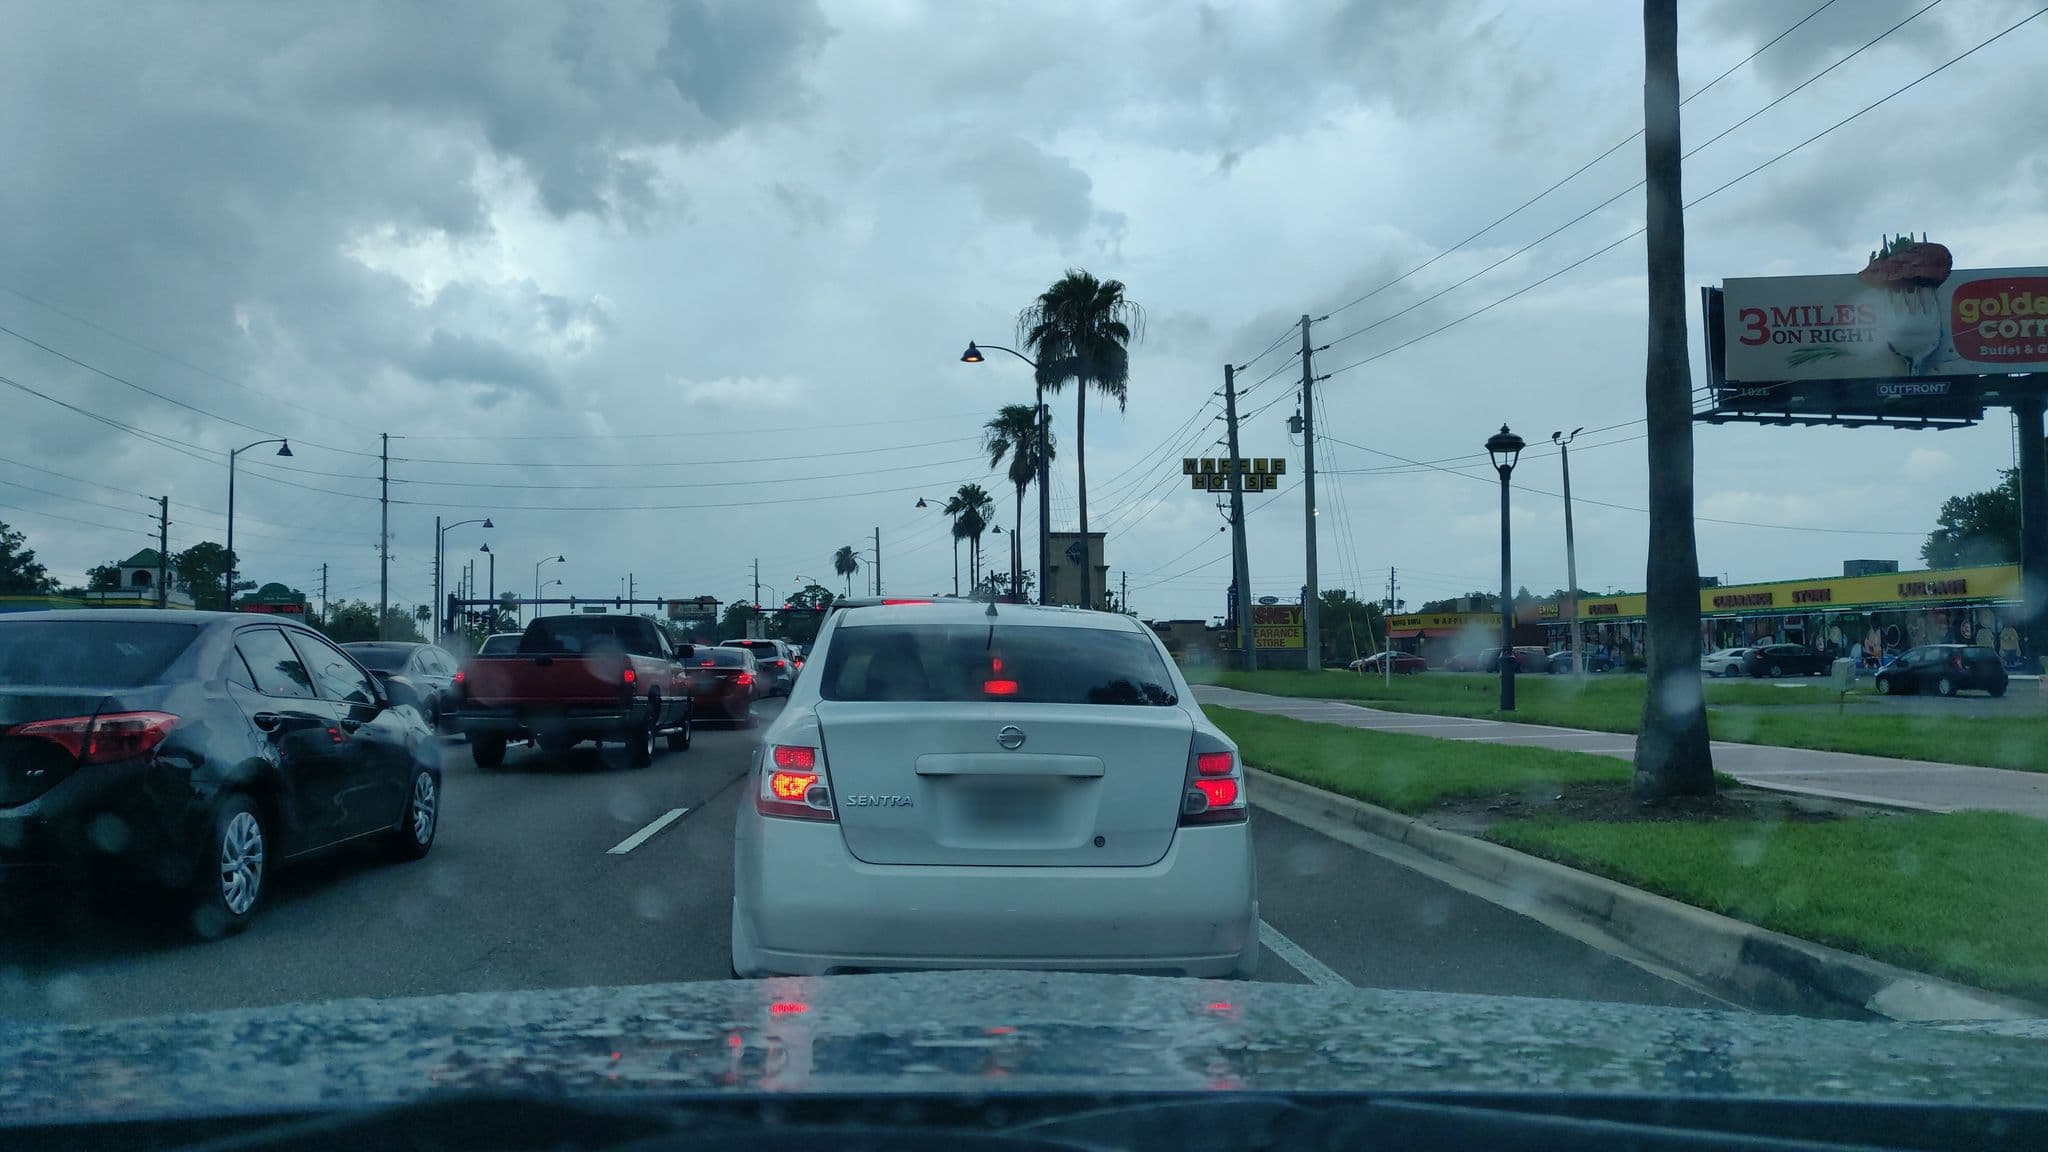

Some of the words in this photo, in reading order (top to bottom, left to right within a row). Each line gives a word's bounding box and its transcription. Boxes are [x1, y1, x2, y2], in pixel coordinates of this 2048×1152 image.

[1739, 307, 1771, 346] 3
[1770, 304, 1876, 327] MILES
[1772, 329, 1806, 345] ON
[1809, 327, 1876, 344] RIGHT
[1979, 344, 2020, 356] Buffet
[2024, 343, 2033, 354] &
[1880, 383, 1947, 394] OUTFRONT
[1185, 459, 1284, 472] WAFFLE
[1194, 476, 1275, 489] HOSE
[1791, 588, 1831, 603] STORE
[1253, 628, 1300, 638] EARANCE
[1256, 639, 1286, 648] STORE
[846, 795, 914, 807] SENTRA
